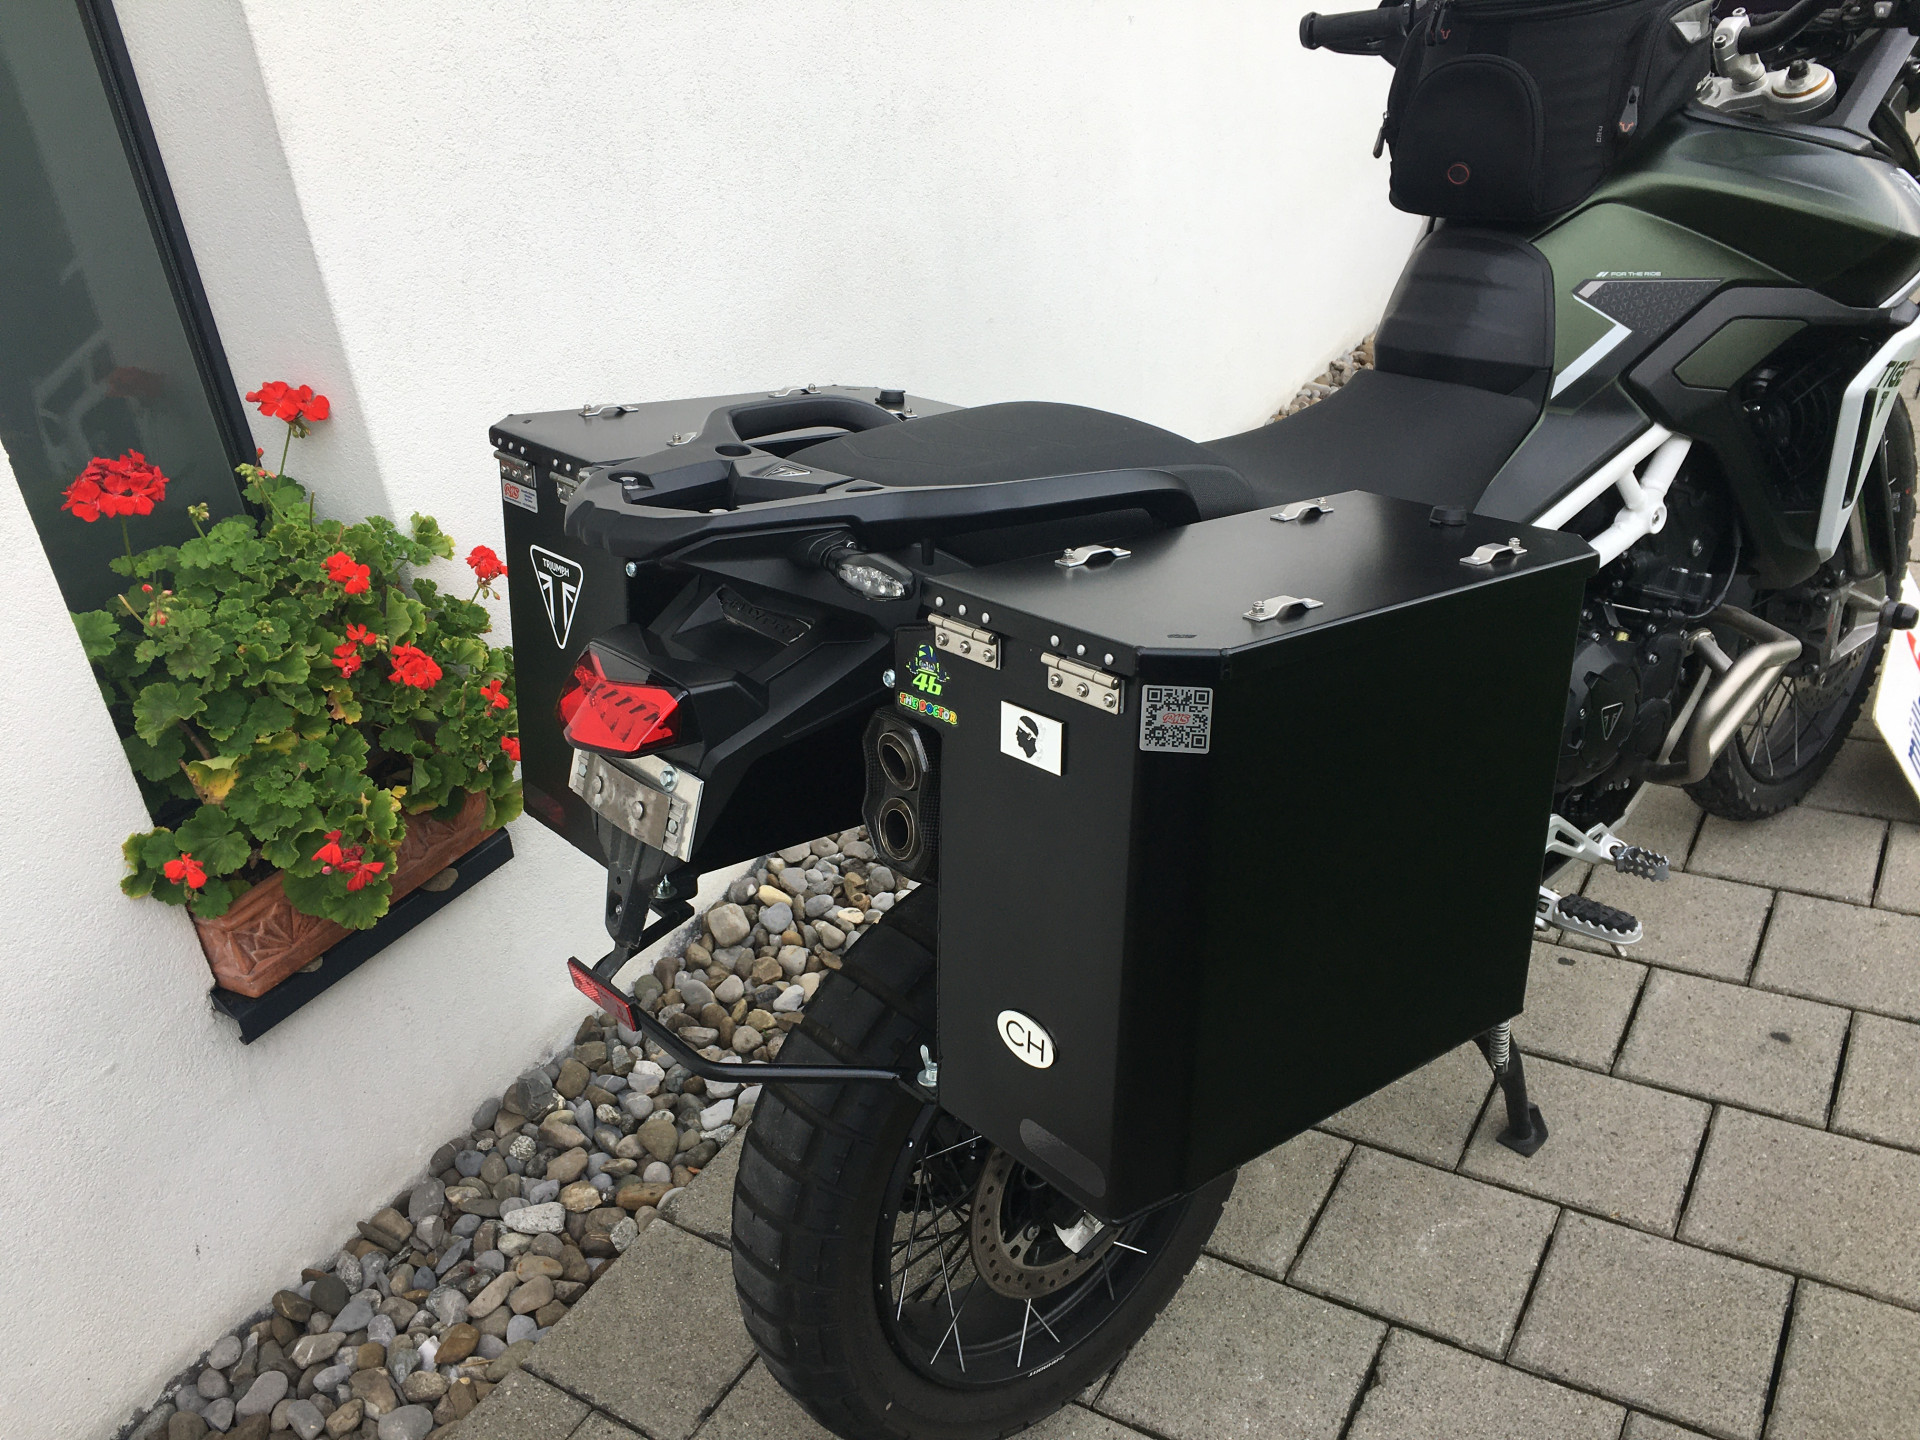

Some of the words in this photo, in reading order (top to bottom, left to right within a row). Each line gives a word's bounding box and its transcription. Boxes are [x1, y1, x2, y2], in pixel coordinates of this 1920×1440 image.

[542, 557, 570, 578] TRIUMPH
[912, 672, 942, 696] 46
[899, 692, 919, 710] THE
[919, 699, 958, 725] DOCTOR
[1006, 1019, 1045, 1063] CH
